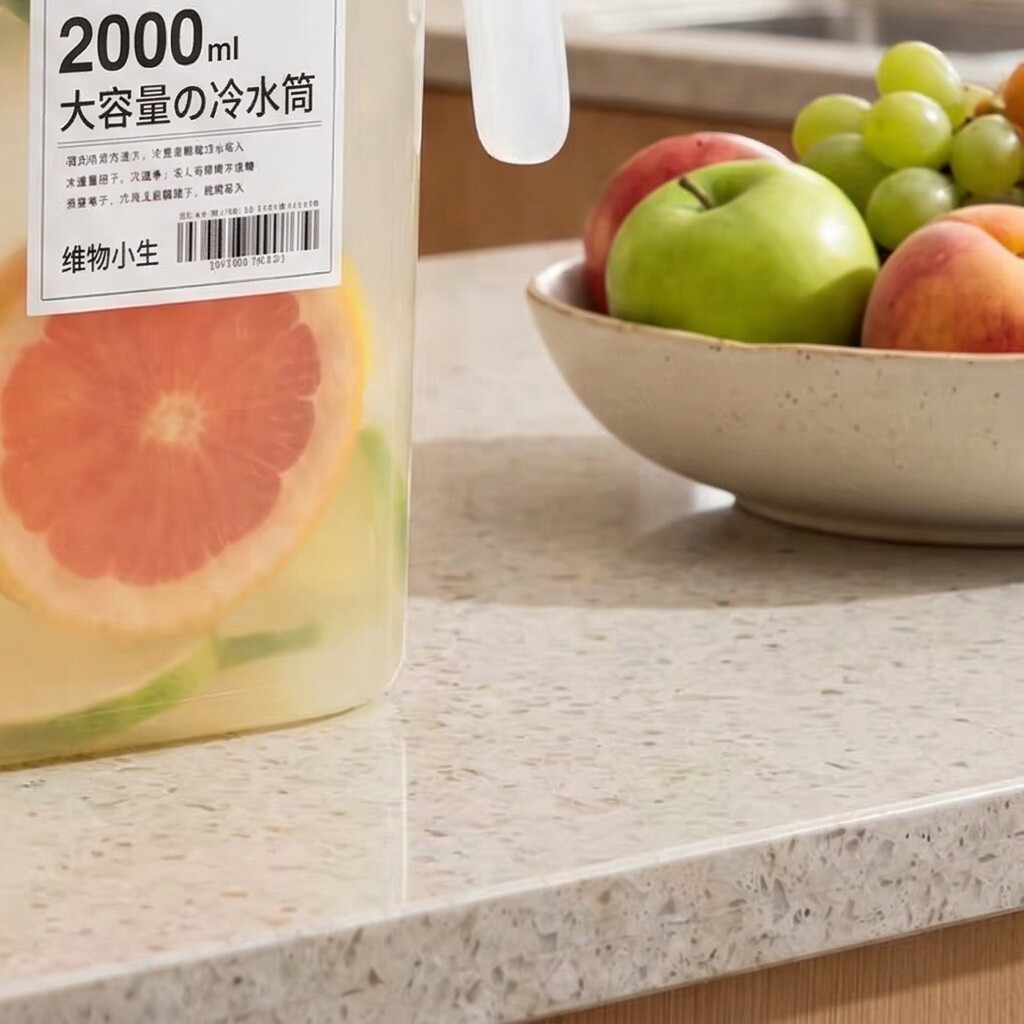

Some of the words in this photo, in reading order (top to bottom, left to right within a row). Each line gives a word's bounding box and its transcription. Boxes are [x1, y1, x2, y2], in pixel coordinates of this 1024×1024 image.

[59, 8, 203, 74] 2000
[207, 35, 240, 63] ml
[59, 72, 316, 133] 大容量の冷水筒
[61, 239, 160, 274] 维物小生
